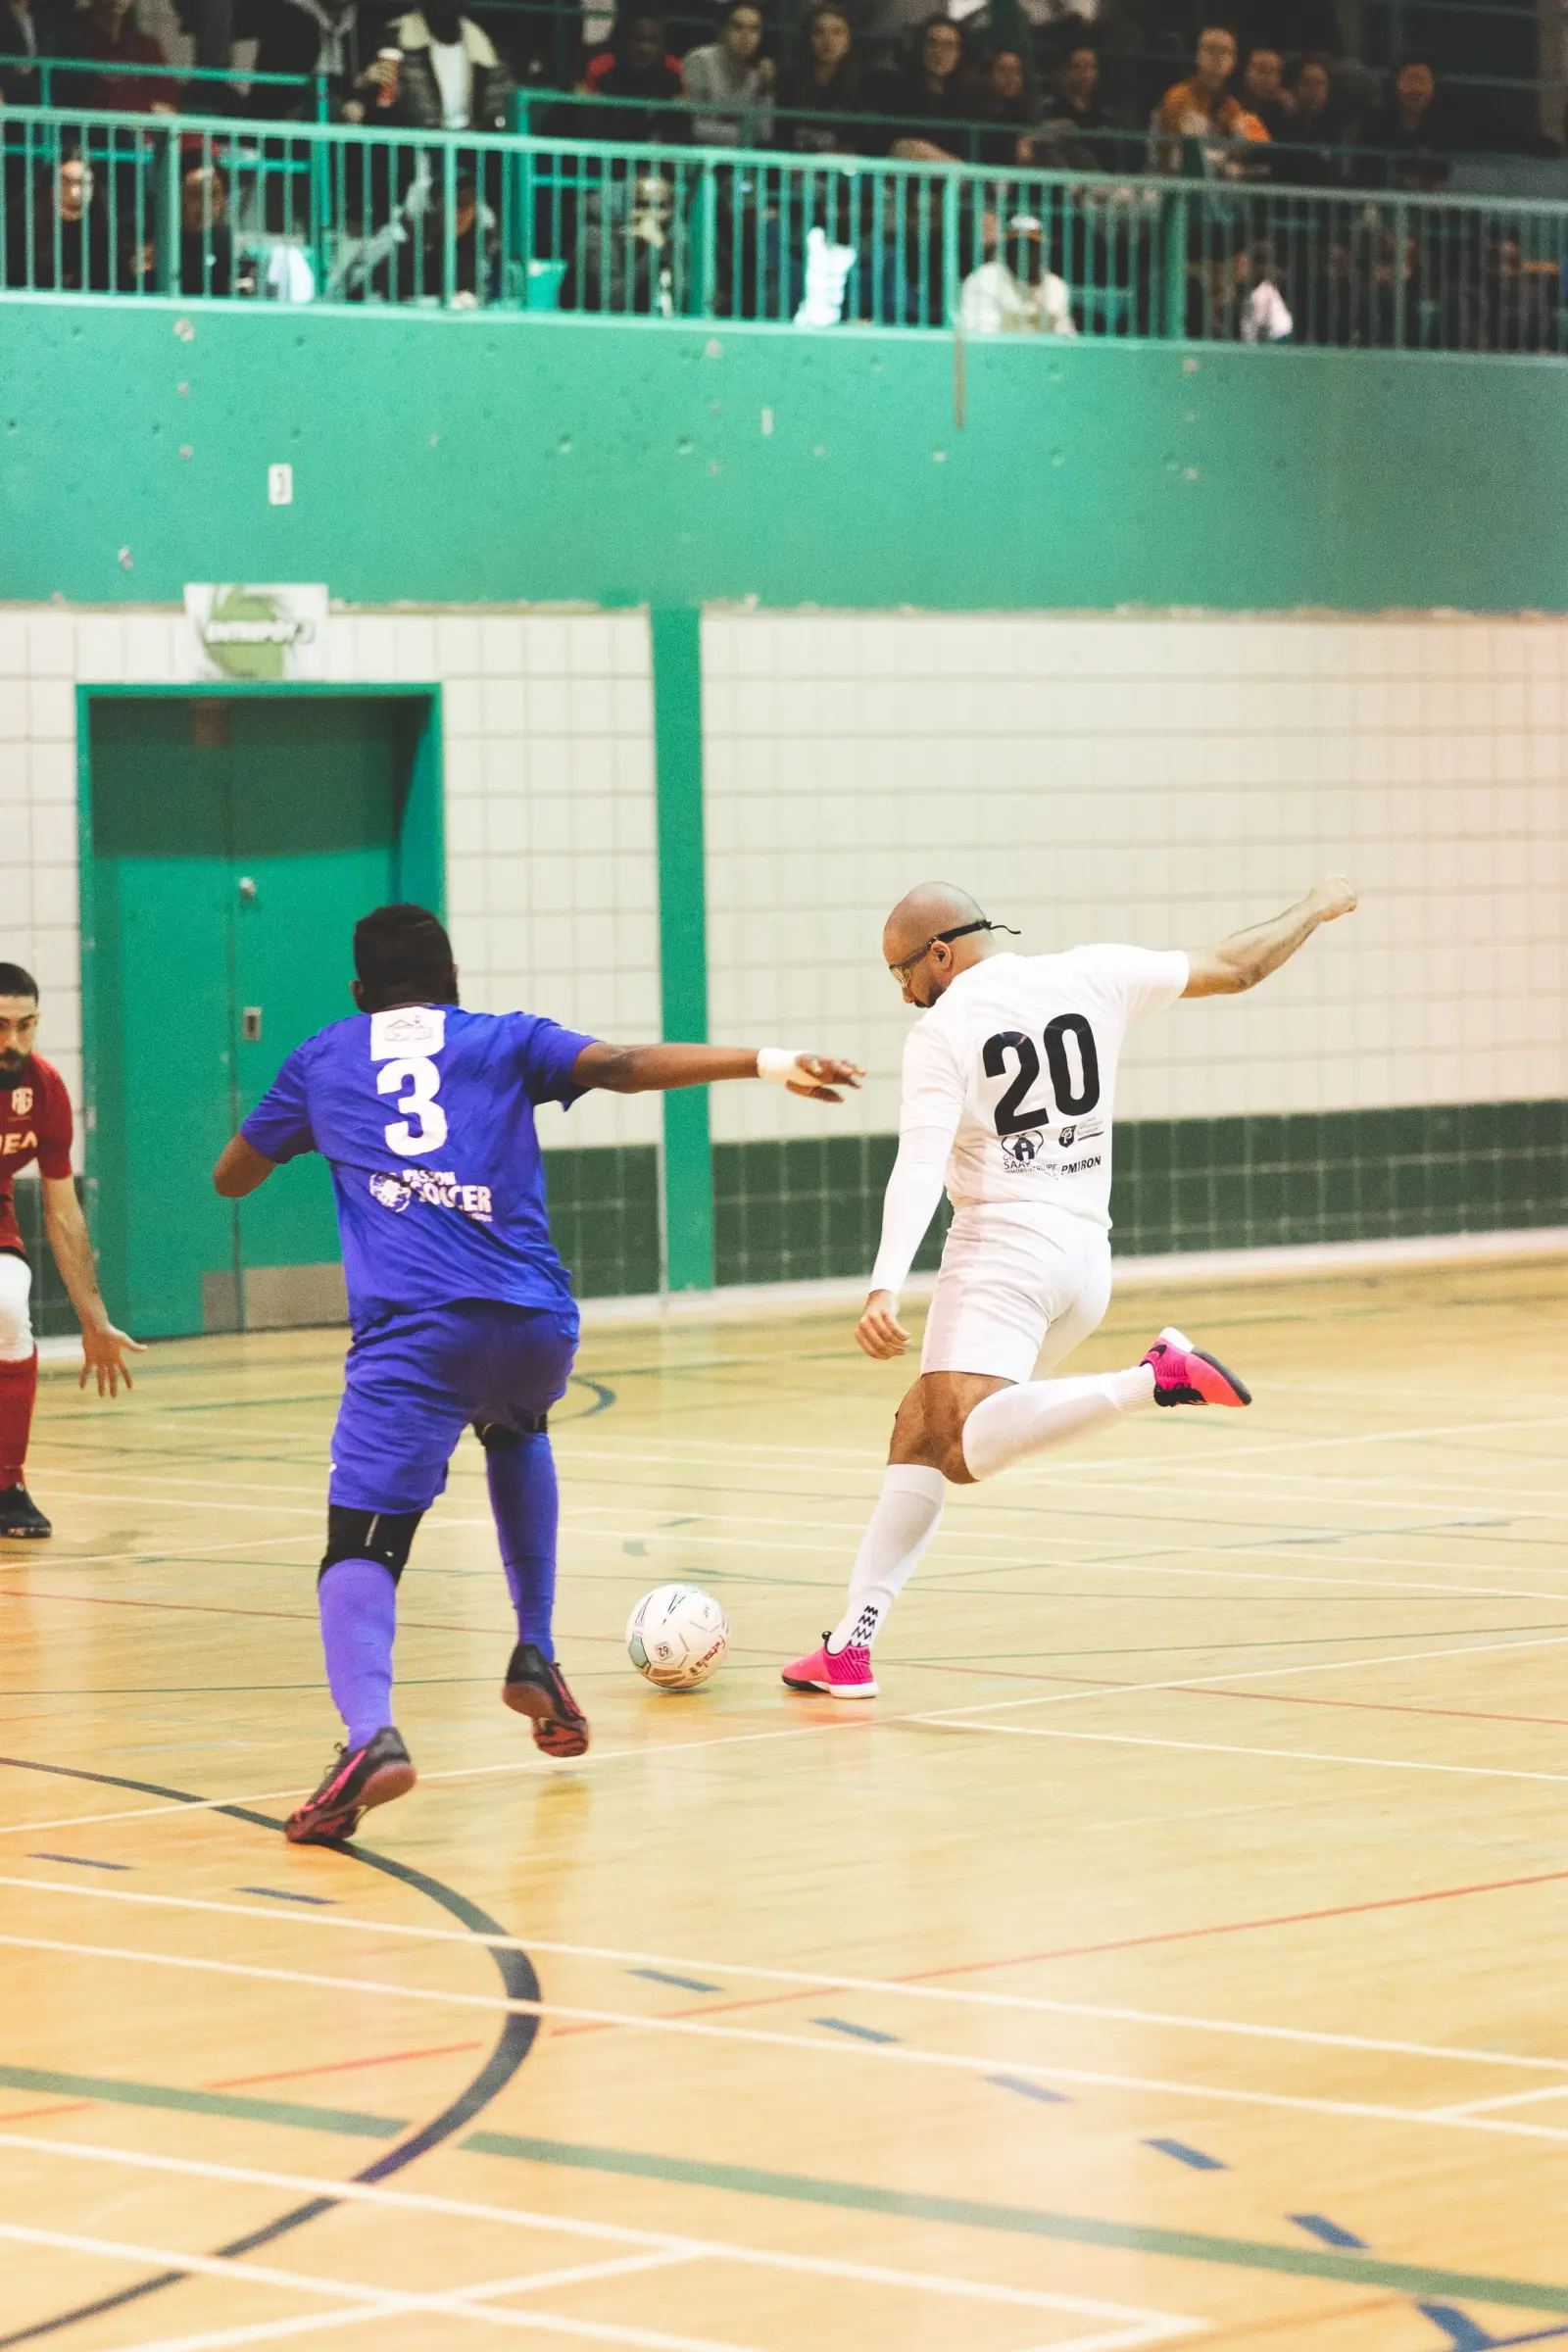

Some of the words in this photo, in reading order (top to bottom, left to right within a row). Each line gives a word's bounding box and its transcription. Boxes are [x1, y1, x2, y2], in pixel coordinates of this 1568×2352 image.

[376, 1056, 448, 1156] 3
[982, 1013, 1101, 1137] 20
[410, 1180, 493, 1213] SOCCER
